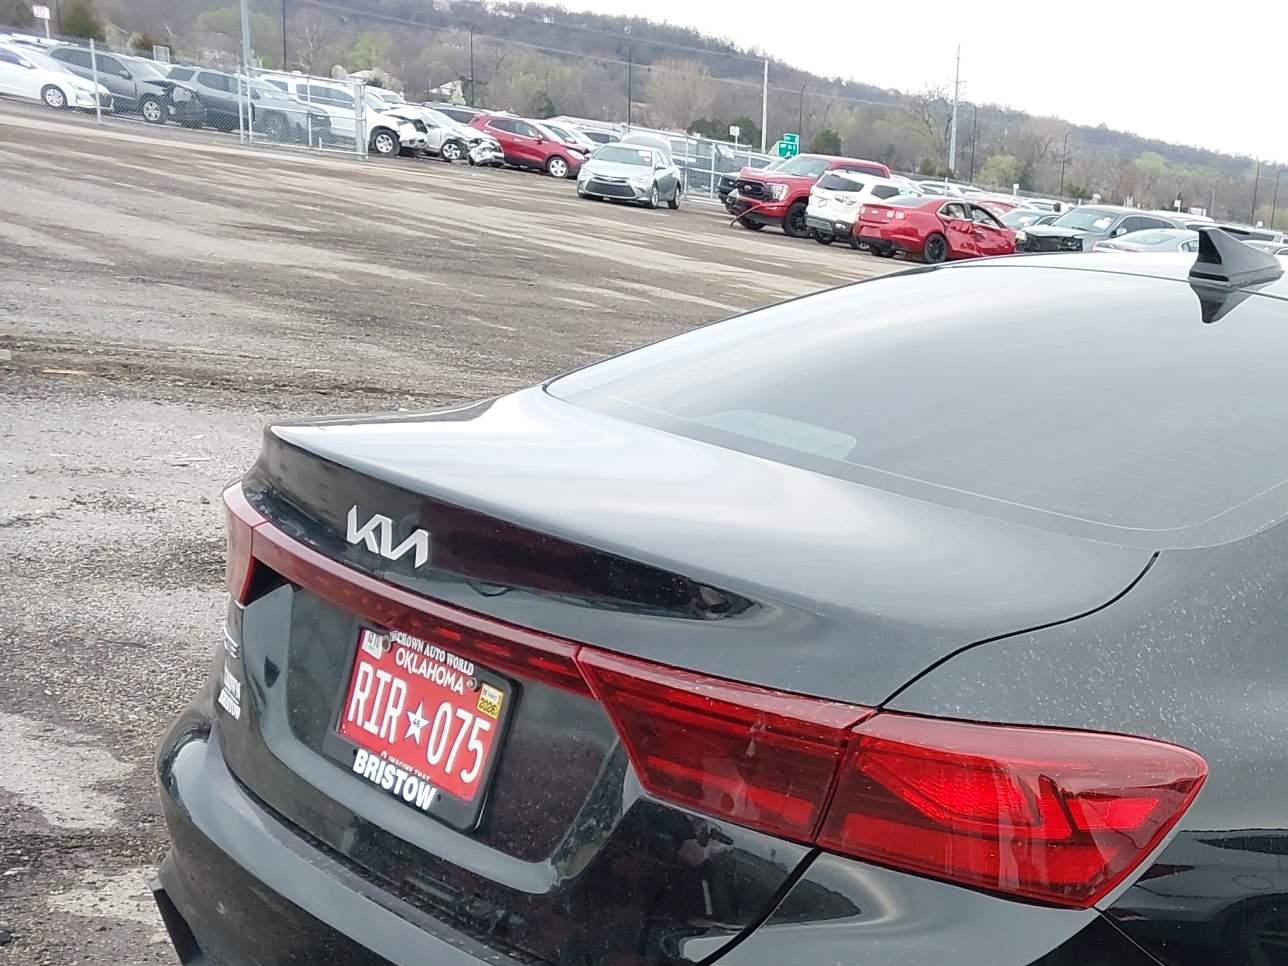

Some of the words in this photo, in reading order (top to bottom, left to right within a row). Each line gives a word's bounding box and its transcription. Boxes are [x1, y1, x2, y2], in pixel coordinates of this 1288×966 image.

[346, 504, 429, 568] KIA
[395, 647, 464, 695] OKLAHOMA
[396, 631, 426, 652] CROWN
[423, 643, 446, 662] AUTO
[446, 651, 475, 676] WORLD
[352, 748, 437, 810] BRISTOW
